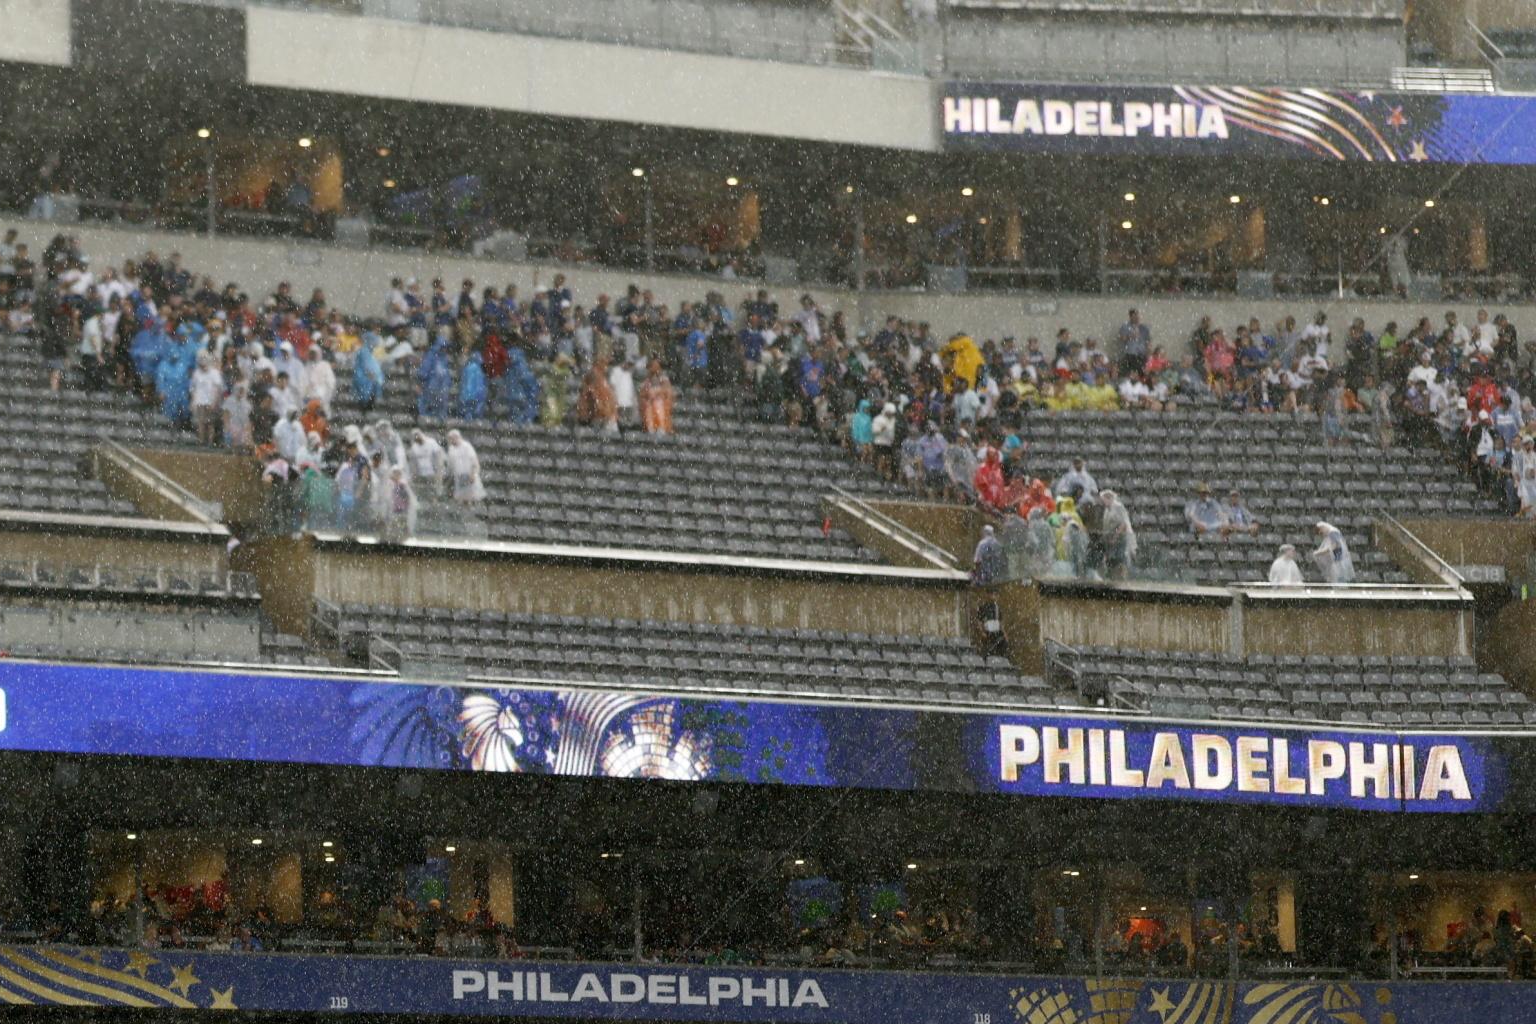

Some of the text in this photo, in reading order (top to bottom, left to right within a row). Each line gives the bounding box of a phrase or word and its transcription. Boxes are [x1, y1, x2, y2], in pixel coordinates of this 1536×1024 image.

[999, 724, 1473, 800] PHILADELPHIA
[452, 969, 830, 1008] PHILADELPHIA
[330, 997, 349, 1009] 119
[974, 1013, 991, 1024] 118
